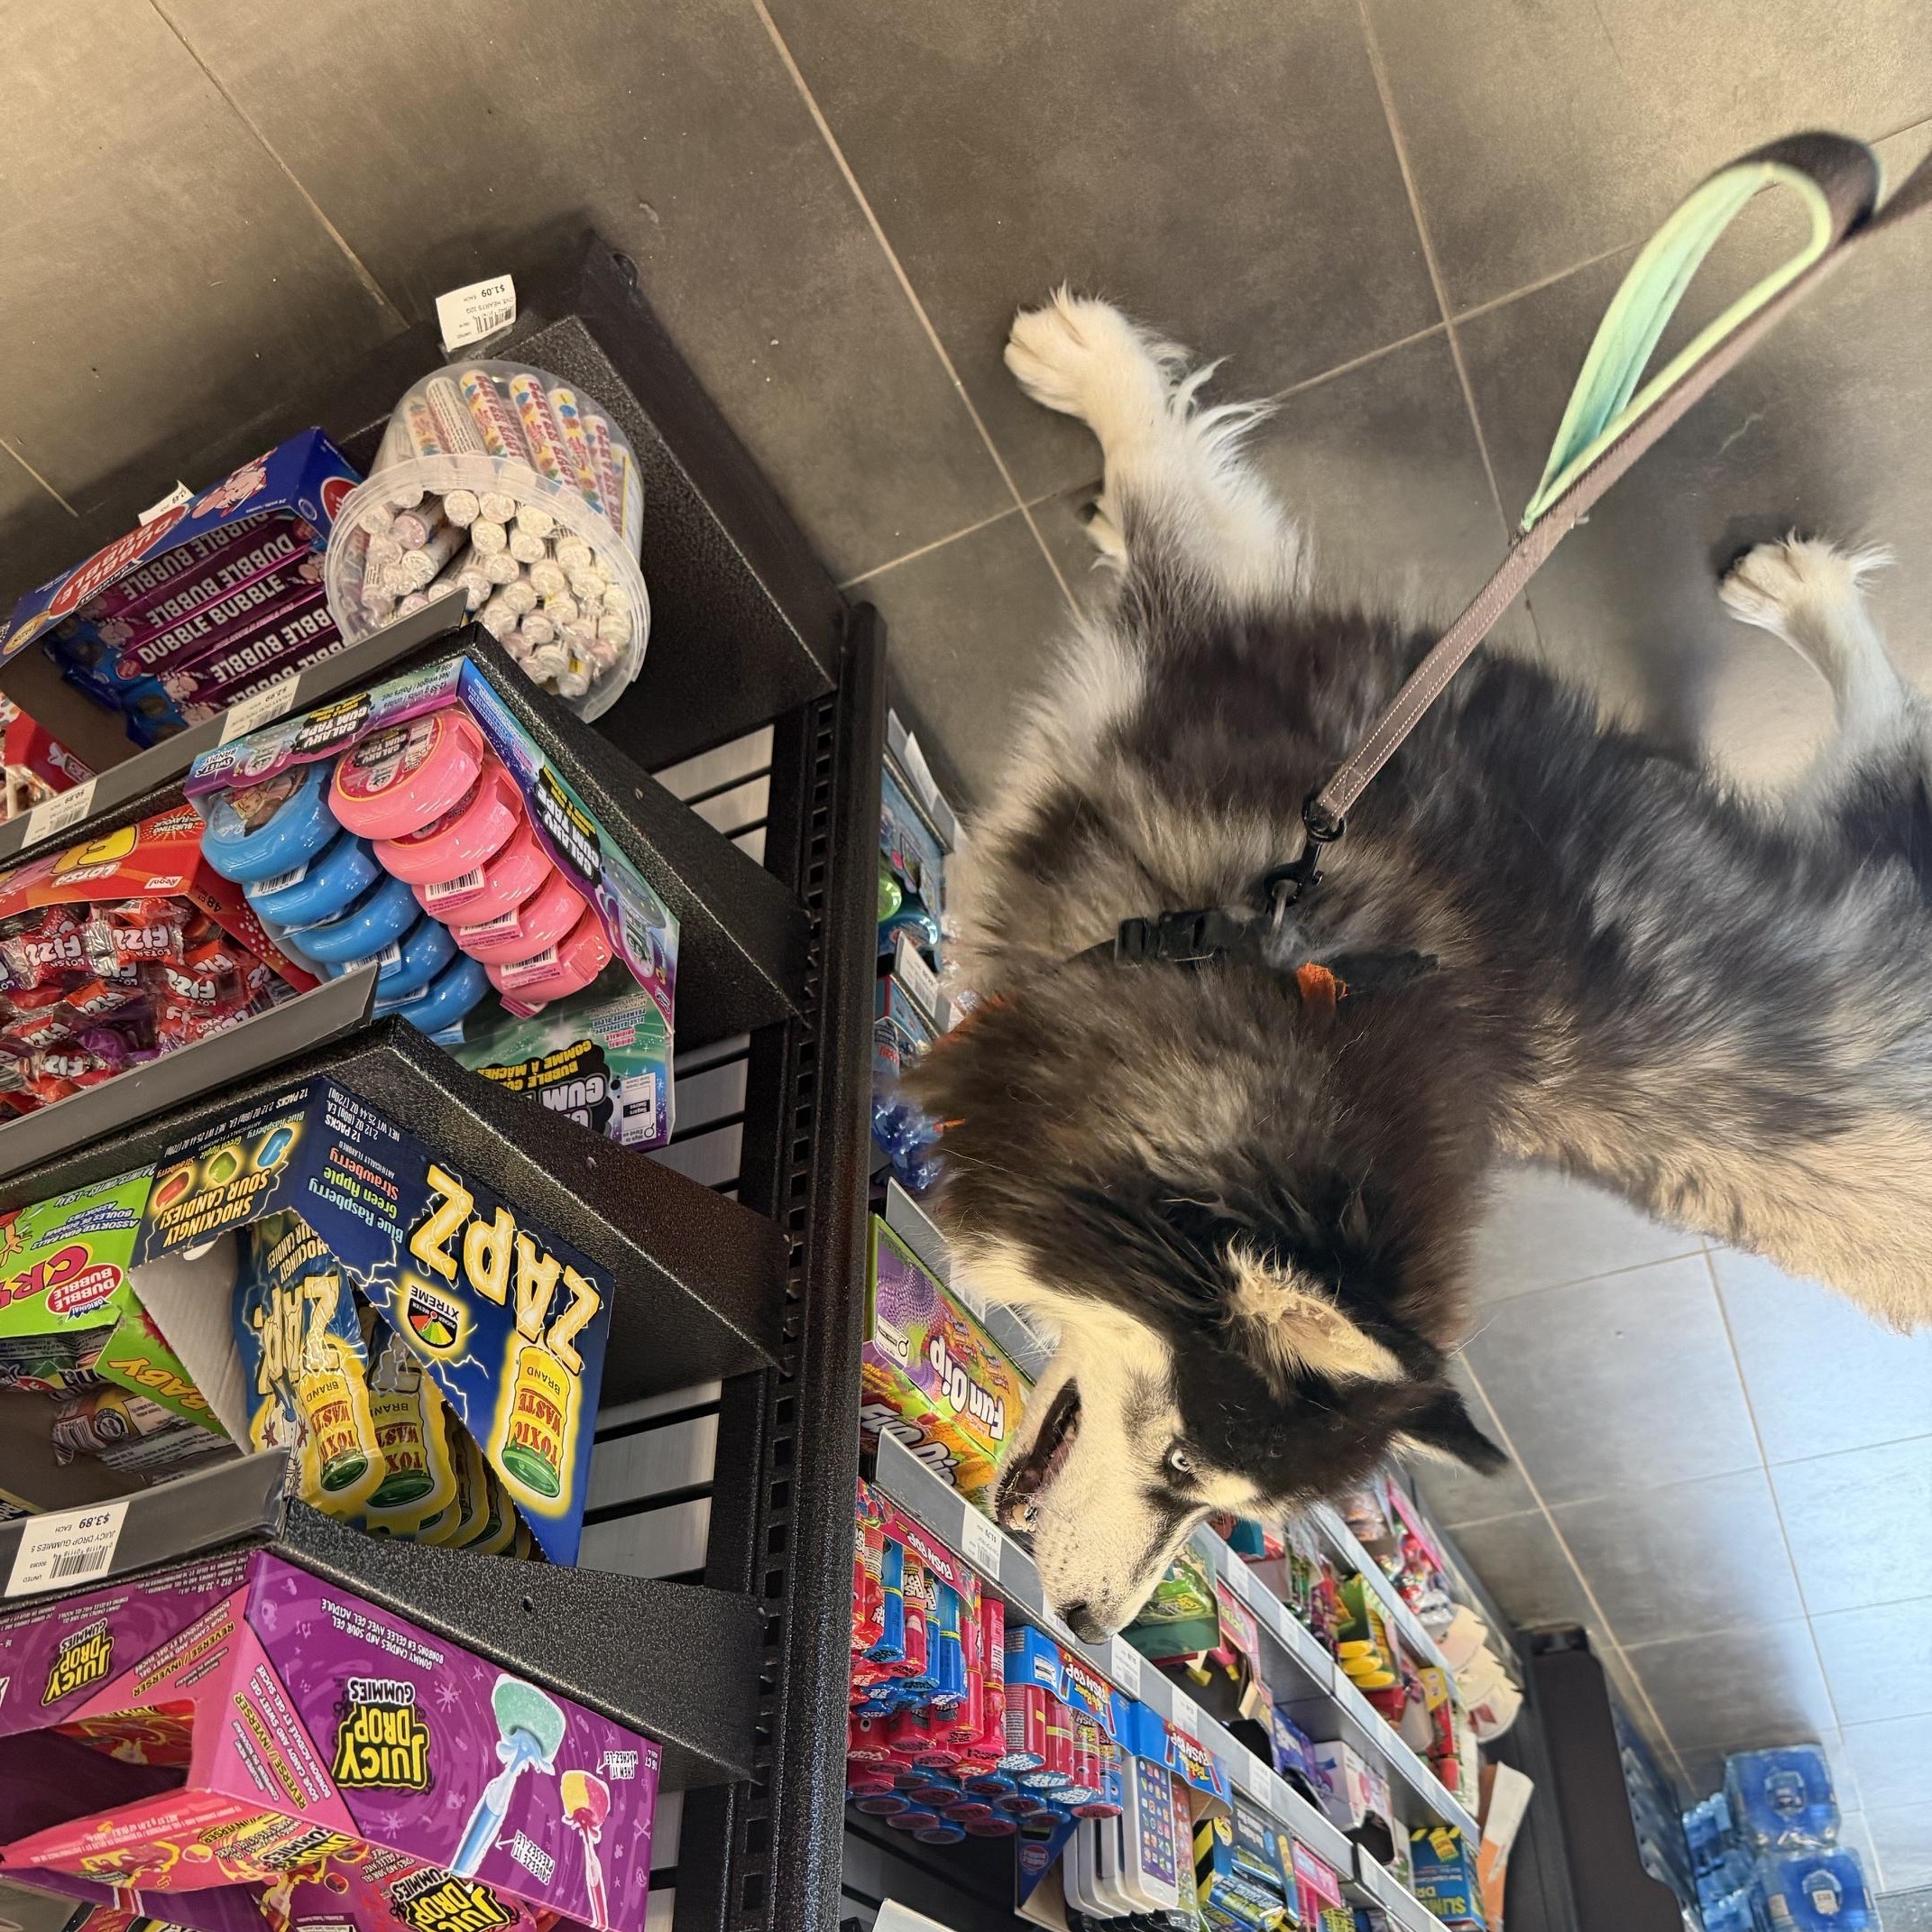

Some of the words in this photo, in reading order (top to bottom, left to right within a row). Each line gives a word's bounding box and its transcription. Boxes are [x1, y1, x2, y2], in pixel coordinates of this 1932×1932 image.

[481, 283, 505, 298] $1.09
[77, 516, 172, 601] DUBBLE
[217, 532, 295, 582] DUBBLE
[118, 547, 190, 600] BUBBLE
[145, 580, 217, 629] BUBBLE
[137, 620, 206, 665] DUBBLE
[207, 574, 286, 627] BUBBLE
[280, 608, 332, 646] BBLE
[209, 634, 284, 684] BUBBLE
[299, 713, 335, 740] TAPE
[335, 705, 367, 727] GUM
[196, 758, 233, 774] SWEET
[204, 748, 237, 764] BANDIT
[536, 783, 569, 830] TAPE
[152, 822, 194, 834] BURSTING
[153, 814, 189, 827] FLAVOUR
[572, 826, 600, 867] GUM
[53, 864, 116, 886] LOTSA
[148, 877, 177, 888] Regal
[206, 895, 222, 914] 48
[23, 934, 81, 966] FIZZ
[112, 925, 170, 951] FIZZ
[476, 1063, 528, 1081] MÂCHE
[528, 1060, 579, 1088] BUBBLE
[276, 1091, 299, 1109] PACKS
[299, 1087, 308, 1099] 12
[542, 1076, 604, 1111] GUM
[287, 1110, 305, 1123] Blue
[327, 1100, 336, 1113] EA.
[351, 1100, 359, 1114] OZ
[360, 1107, 376, 1126] 25.44
[325, 1113, 351, 1136] PACKS
[352, 1129, 361, 1142] 12
[356, 1118, 363, 1131] OZ
[364, 1125, 378, 1140] 2.12
[376, 1118, 387, 1133] WT
[388, 1127, 400, 1142] NET
[219, 1136, 242, 1150] Green
[338, 1140, 363, 1161] FLAVORED
[143, 1165, 155, 1178] 24
[156, 1155, 195, 1178] Strawberry
[329, 1147, 399, 1201] Strawberry
[364, 1155, 395, 1180] ARTIFICIALLY
[227, 1168, 271, 1201] SOUR
[324, 1166, 361, 1197] Apple
[159, 1187, 225, 1229] CANDIES!
[308, 1177, 374, 1228] Raspberry
[363, 1188, 397, 1219] Green
[82, 1219, 138, 1233] ASSORTED
[93, 1210, 132, 1221] BOULES
[162, 1195, 253, 1247] SHOCKINGLY
[377, 1217, 403, 1243] Blue
[280, 1237, 327, 1283] HOCKINGLY
[409, 1164, 601, 1376] ZAPZ
[53, 1267, 112, 1299] BUBBLE
[54, 1277, 115, 1311] DUBBLE
[410, 1284, 460, 1320] XTREME
[107, 1357, 206, 1411] BABY
[526, 1366, 560, 1395] BRAND
[928, 1336, 969, 1412] Dip
[305, 1380, 339, 1403] BRAND
[370, 1403, 408, 1417] BRAN
[518, 1394, 560, 1437] WASTE
[968, 1379, 1005, 1441] Fun
[374, 1425, 419, 1449] WAST
[513, 1421, 557, 1466] TOXIC
[385, 1450, 423, 1474] TOX
[78, 1512, 110, 1529] $3.89
[36, 1539, 70, 1550] GUMMIES
[72, 1534, 94, 1546] DROP
[94, 1530, 115, 1541] JUICY
[906, 1531, 927, 1559] POP
[926, 1547, 954, 1581] PUSH
[332, 1615, 345, 1629] GEL
[346, 1623, 363, 1638] SOUR
[354, 1612, 366, 1628] GEL
[60, 1620, 106, 1651] GUMMIES
[189, 1624, 209, 1642] CANDY
[190, 1623, 234, 1658] REVERSE
[365, 1633, 380, 1645] AND
[60, 1634, 101, 1673] DROP
[174, 1642, 189, 1655] AND
[382, 1639, 408, 1659] CANDIES
[409, 1651, 432, 1670] GUMMY
[47, 1643, 110, 1701] JUICY
[133, 1659, 182, 1697] INVERSER
[1065, 1662, 1086, 1686] POP
[250, 1677, 262, 1697] GEL
[349, 1679, 414, 1704] GUMMIES
[1086, 1674, 1109, 1705] PUSH
[259, 1696, 279, 1726] SWEET
[274, 1694, 286, 1713] GEL
[234, 1693, 271, 1752] INVERSER
[282, 1712, 293, 1725] ET
[354, 1706, 409, 1746] DROP
[276, 1726, 290, 1746] AND
[286, 1747, 306, 1777] CANDY
[339, 1733, 424, 1782] JUICY
[274, 1756, 307, 1810] REVERSE
[303, 1775, 319, 1801] SOUR
[411, 1882, 472, 1924] DROP
